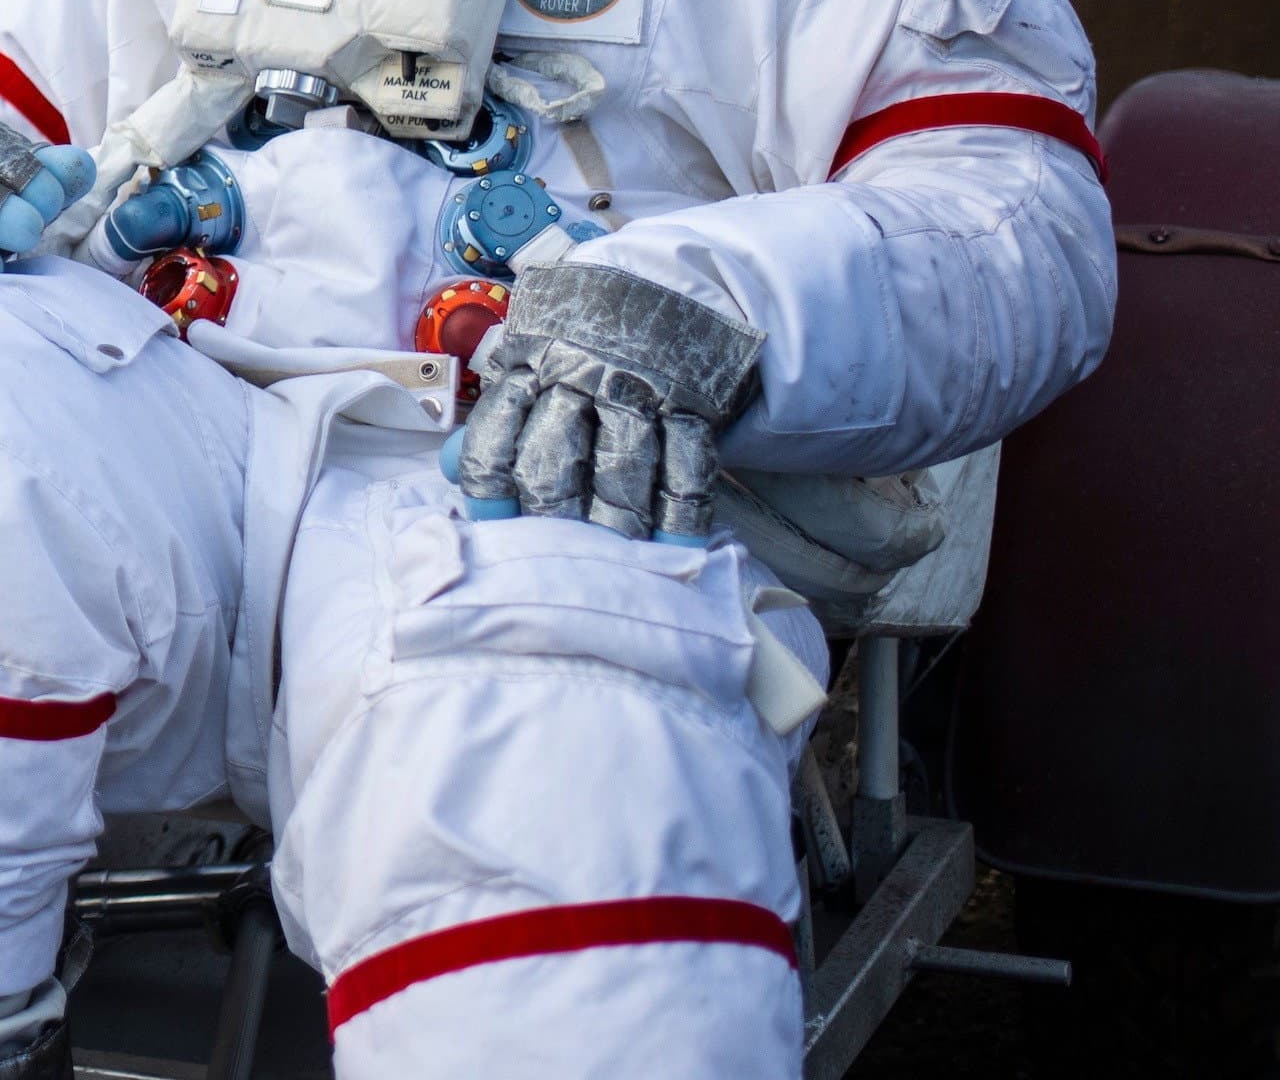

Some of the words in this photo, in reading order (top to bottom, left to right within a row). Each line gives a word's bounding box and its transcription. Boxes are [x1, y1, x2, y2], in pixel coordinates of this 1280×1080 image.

[384, 77, 415, 86] MAIN
[419, 78, 450, 89] MOM
[401, 89, 428, 100] TALK
[387, 115, 404, 125] ON
